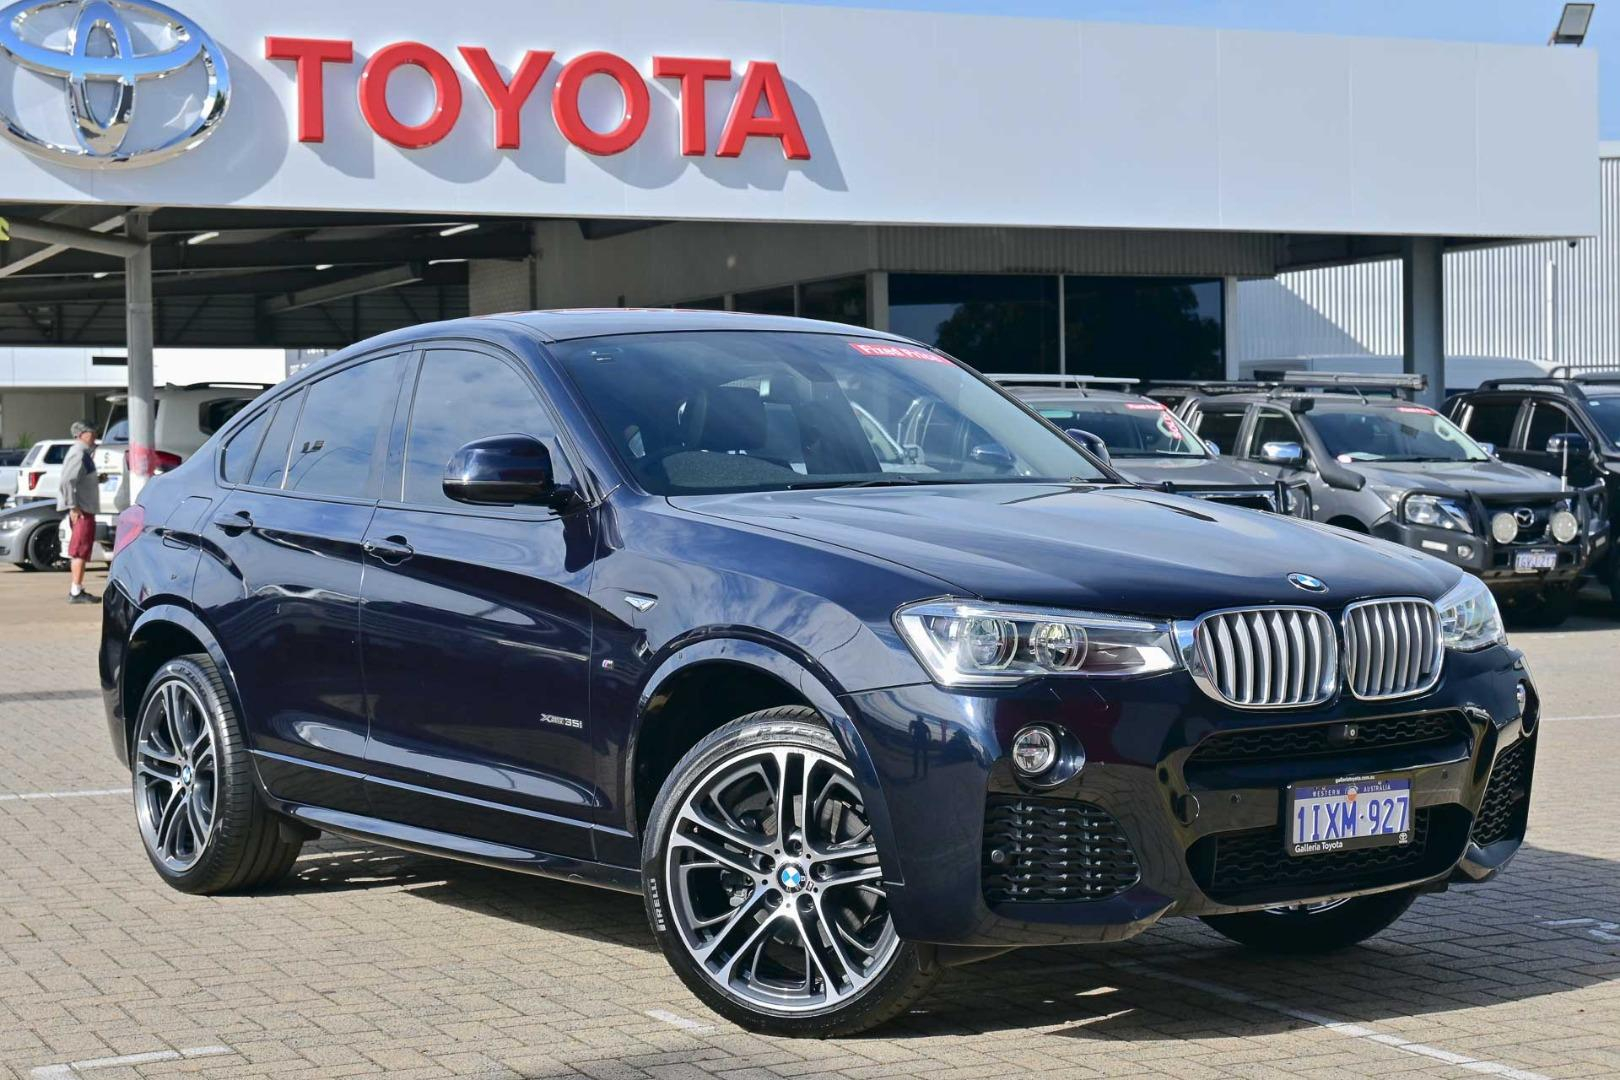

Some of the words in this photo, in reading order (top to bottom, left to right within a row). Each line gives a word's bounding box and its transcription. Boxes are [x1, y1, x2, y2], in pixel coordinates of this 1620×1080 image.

[265, 36, 811, 160] TOYOTA
[857, 344, 901, 356] Fixed
[1313, 789, 1341, 797] WESTERN
[1363, 783, 1392, 792] AUSTRALIA
[1295, 843, 1321, 853] Galleria
[1321, 841, 1344, 851] Toyota
[648, 877, 668, 933] PIRELLI
